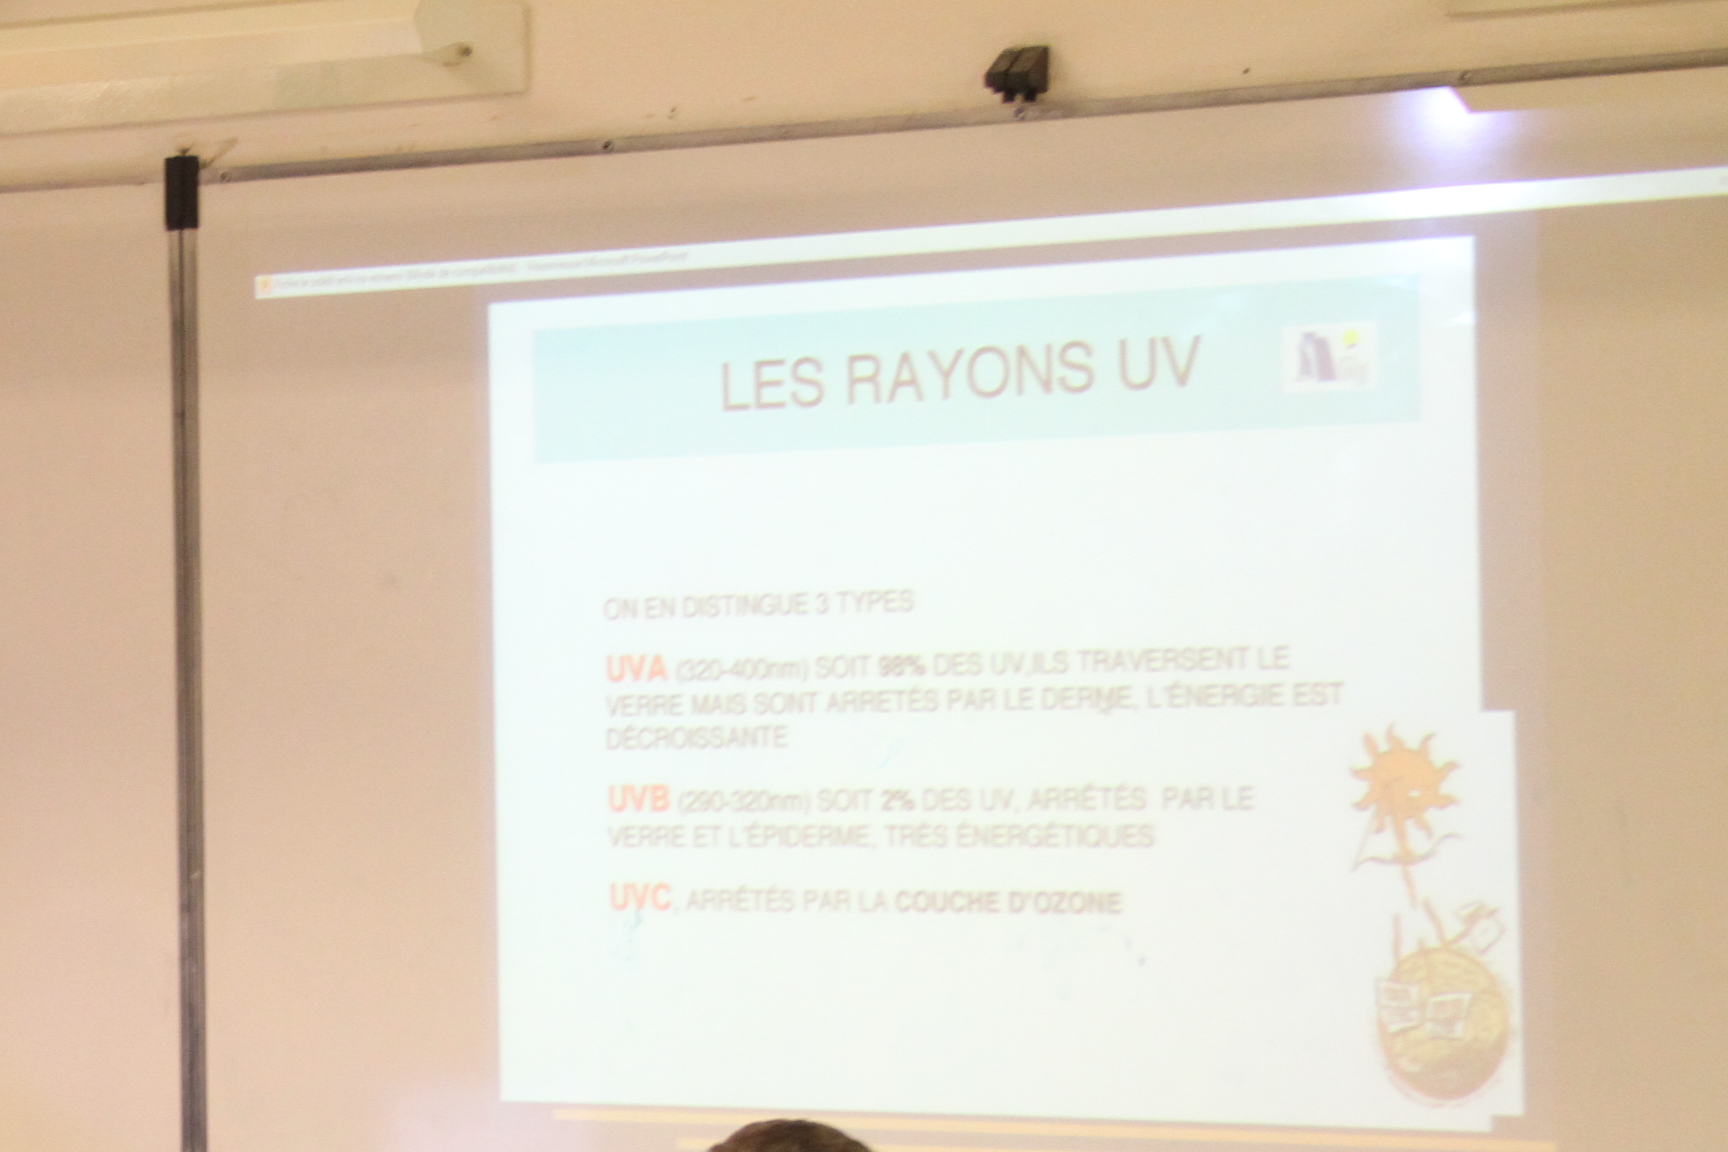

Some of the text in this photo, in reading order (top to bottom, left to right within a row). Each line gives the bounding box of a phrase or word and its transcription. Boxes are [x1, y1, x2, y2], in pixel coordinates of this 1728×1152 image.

[721, 335, 1203, 411] LES RAYONS UV
[603, 589, 916, 621] ON EN DISTINGUE 3 TYPES
[605, 653, 669, 683] UVA
[815, 655, 872, 680] SOIT
[877, 654, 928, 678] 98%
[933, 652, 983, 677] DES
[1077, 645, 1251, 674] TRAVERSENT
[1256, 644, 1291, 670] LE
[605, 693, 684, 718] VERRE
[691, 692, 748, 716] MAIS
[753, 690, 819, 715] SONT
[946, 688, 996, 711] PAR
[1004, 686, 1033, 711] LE
[1291, 680, 1345, 706] EST
[605, 723, 790, 751] DÉCROISSANTE
[607, 783, 671, 814] UVB
[817, 788, 875, 813] SOIT
[880, 788, 917, 812] 2%
[921, 787, 972, 812] DES
[1161, 785, 1214, 811] PAR
[1222, 784, 1256, 811] LE
[607, 824, 686, 849] VERRE
[692, 824, 722, 848] ET
[802, 888, 852, 912] PAR
[857, 888, 887, 913] LA
[894, 889, 1001, 914] COUCHE
